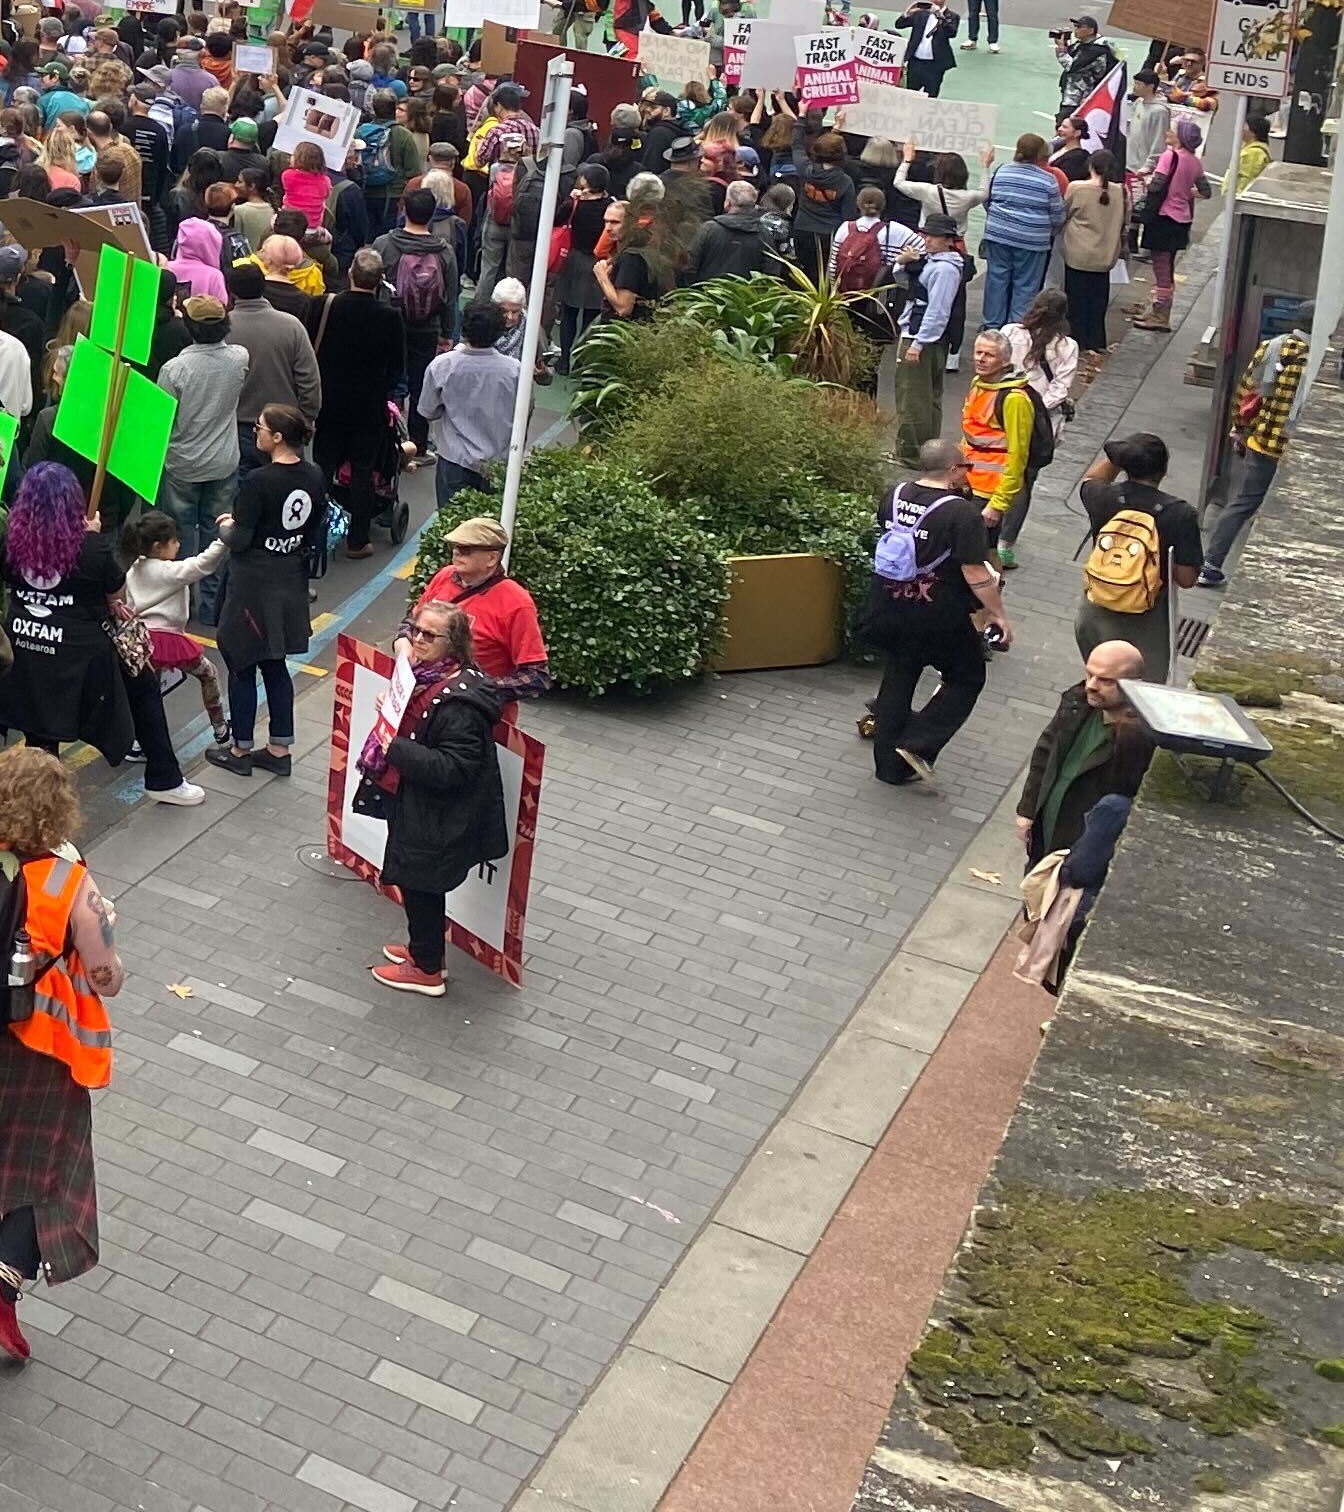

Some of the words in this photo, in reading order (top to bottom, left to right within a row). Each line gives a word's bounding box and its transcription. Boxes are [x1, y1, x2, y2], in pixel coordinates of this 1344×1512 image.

[810, 38, 840, 51] FAST
[865, 35, 894, 50] FAST
[805, 49, 847, 65] TRACK
[859, 45, 897, 64] TRACK
[803, 70, 853, 86] ANIMAL
[1223, 70, 1269, 88] ENDS
[802, 81, 859, 100] CRUELTY
[896, 499, 928, 515] DIVIDE
[897, 512, 917, 525] AND
[12, 617, 63, 643] OXFAM
[15, 638, 56, 656] Aotearoa
